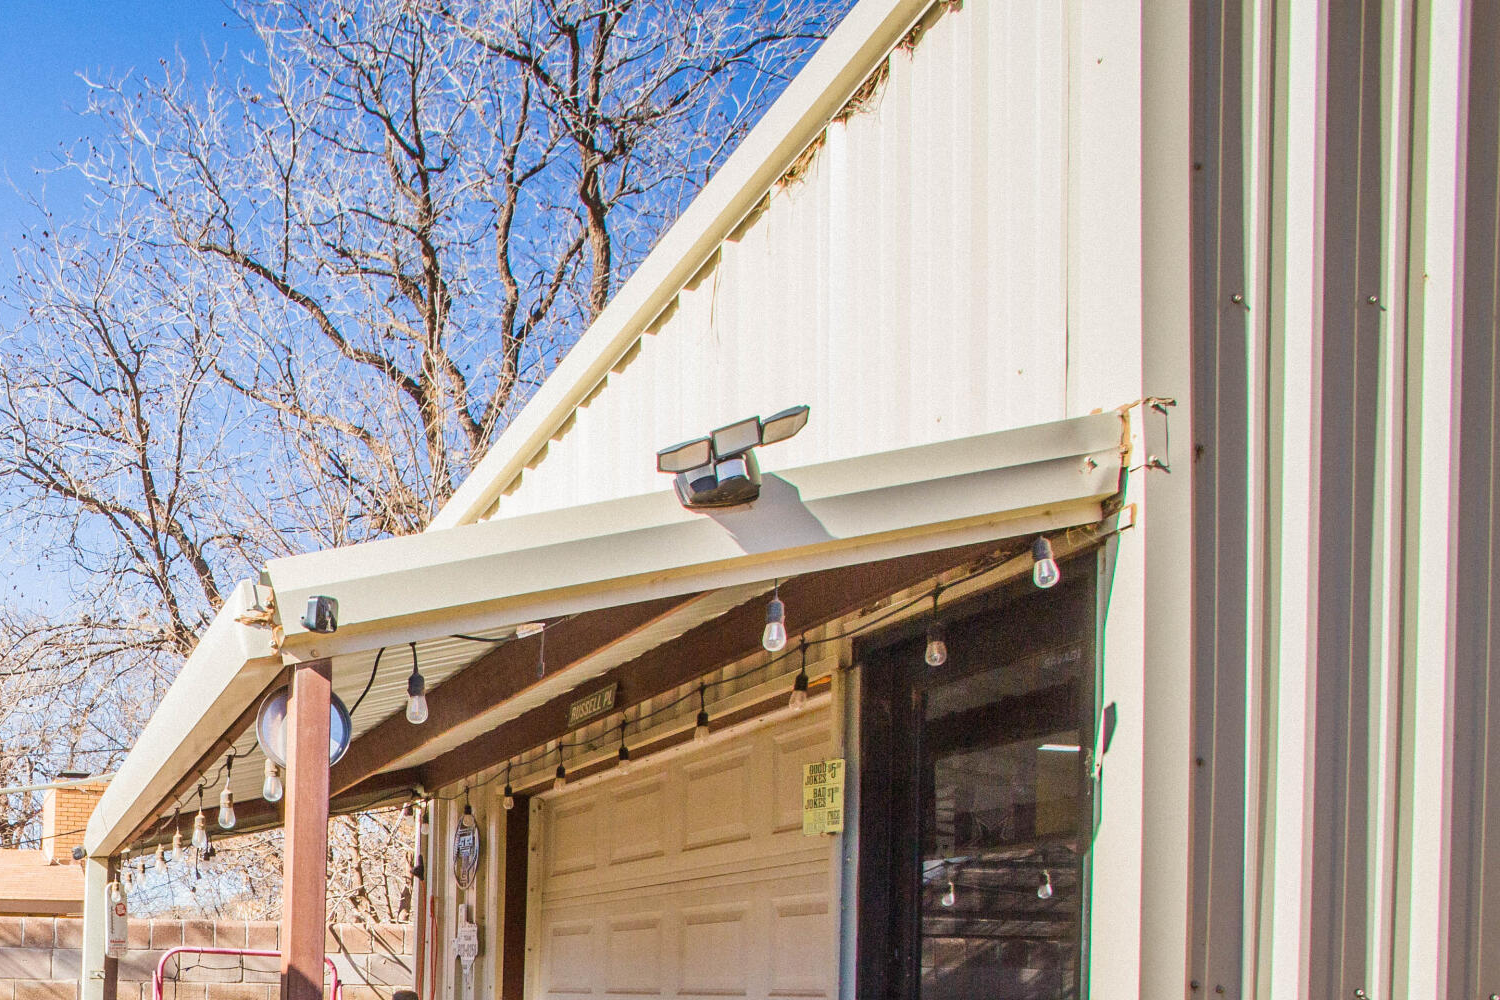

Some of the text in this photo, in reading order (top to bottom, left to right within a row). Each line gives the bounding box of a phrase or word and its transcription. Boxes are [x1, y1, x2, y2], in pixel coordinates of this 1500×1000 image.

[571, 694, 601, 721] RUSSELL
[809, 762, 826, 774] GOOD
[805, 774, 826, 785] JOKES
[813, 787, 826, 798] BAD
[805, 798, 826, 809] JOKES
